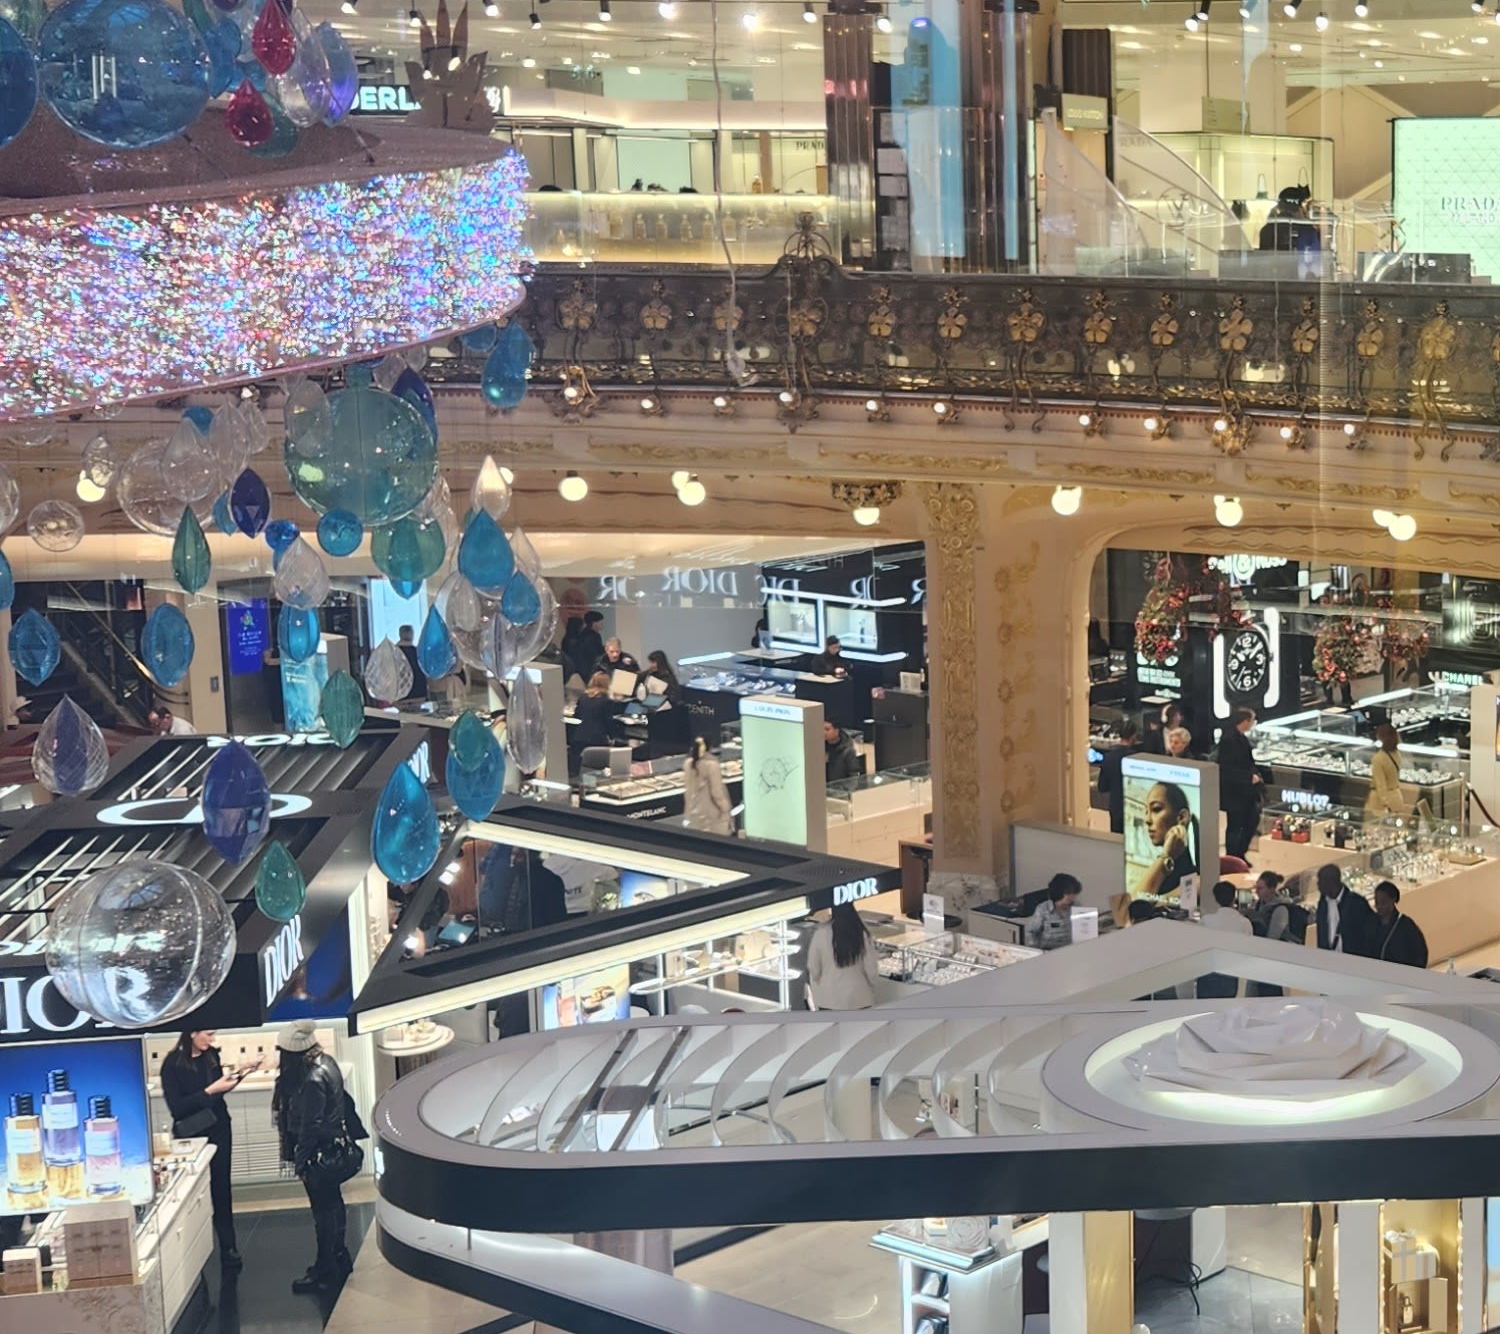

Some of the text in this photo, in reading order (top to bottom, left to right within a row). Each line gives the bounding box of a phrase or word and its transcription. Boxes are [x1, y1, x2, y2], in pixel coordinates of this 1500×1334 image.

[1242, 637, 1252, 648] 12
[1256, 655, 1265, 665] 3
[1243, 677, 1251, 687] 6
[1443, 671, 1482, 686] CHANEL
[833, 877, 879, 907] DIOR
[1137, 890, 1168, 904] MICHAEL
[264, 914, 305, 1009] DIOR
